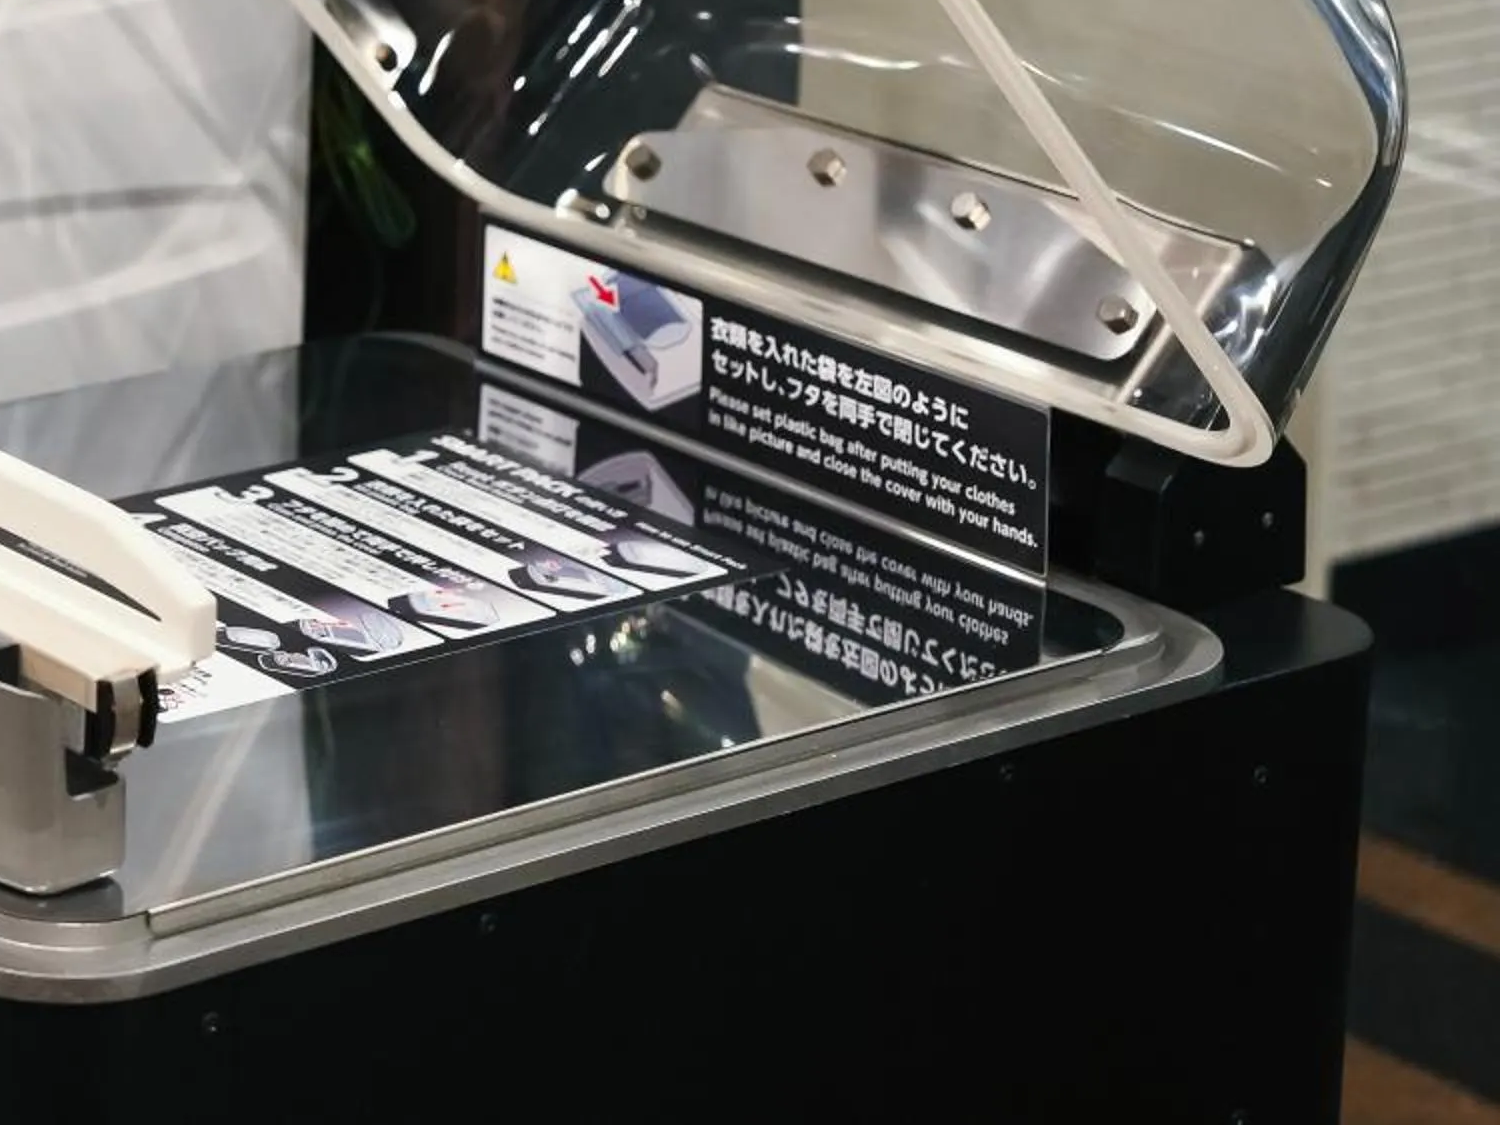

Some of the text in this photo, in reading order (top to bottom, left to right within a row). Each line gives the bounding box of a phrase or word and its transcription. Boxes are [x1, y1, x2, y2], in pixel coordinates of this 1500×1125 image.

[710, 317, 970, 431] 衣類を入れた袋を左図のように
[709, 385, 1016, 516] Please set plastic bag after putting your clothes
[749, 425, 794, 455] picture
[795, 444, 822, 465] and
[824, 449, 857, 479] close
[860, 464, 882, 489] the
[885, 479, 923, 505] cover
[925, 491, 956, 517] with
[958, 507, 990, 530] your
[992, 516, 1039, 549] hands.
